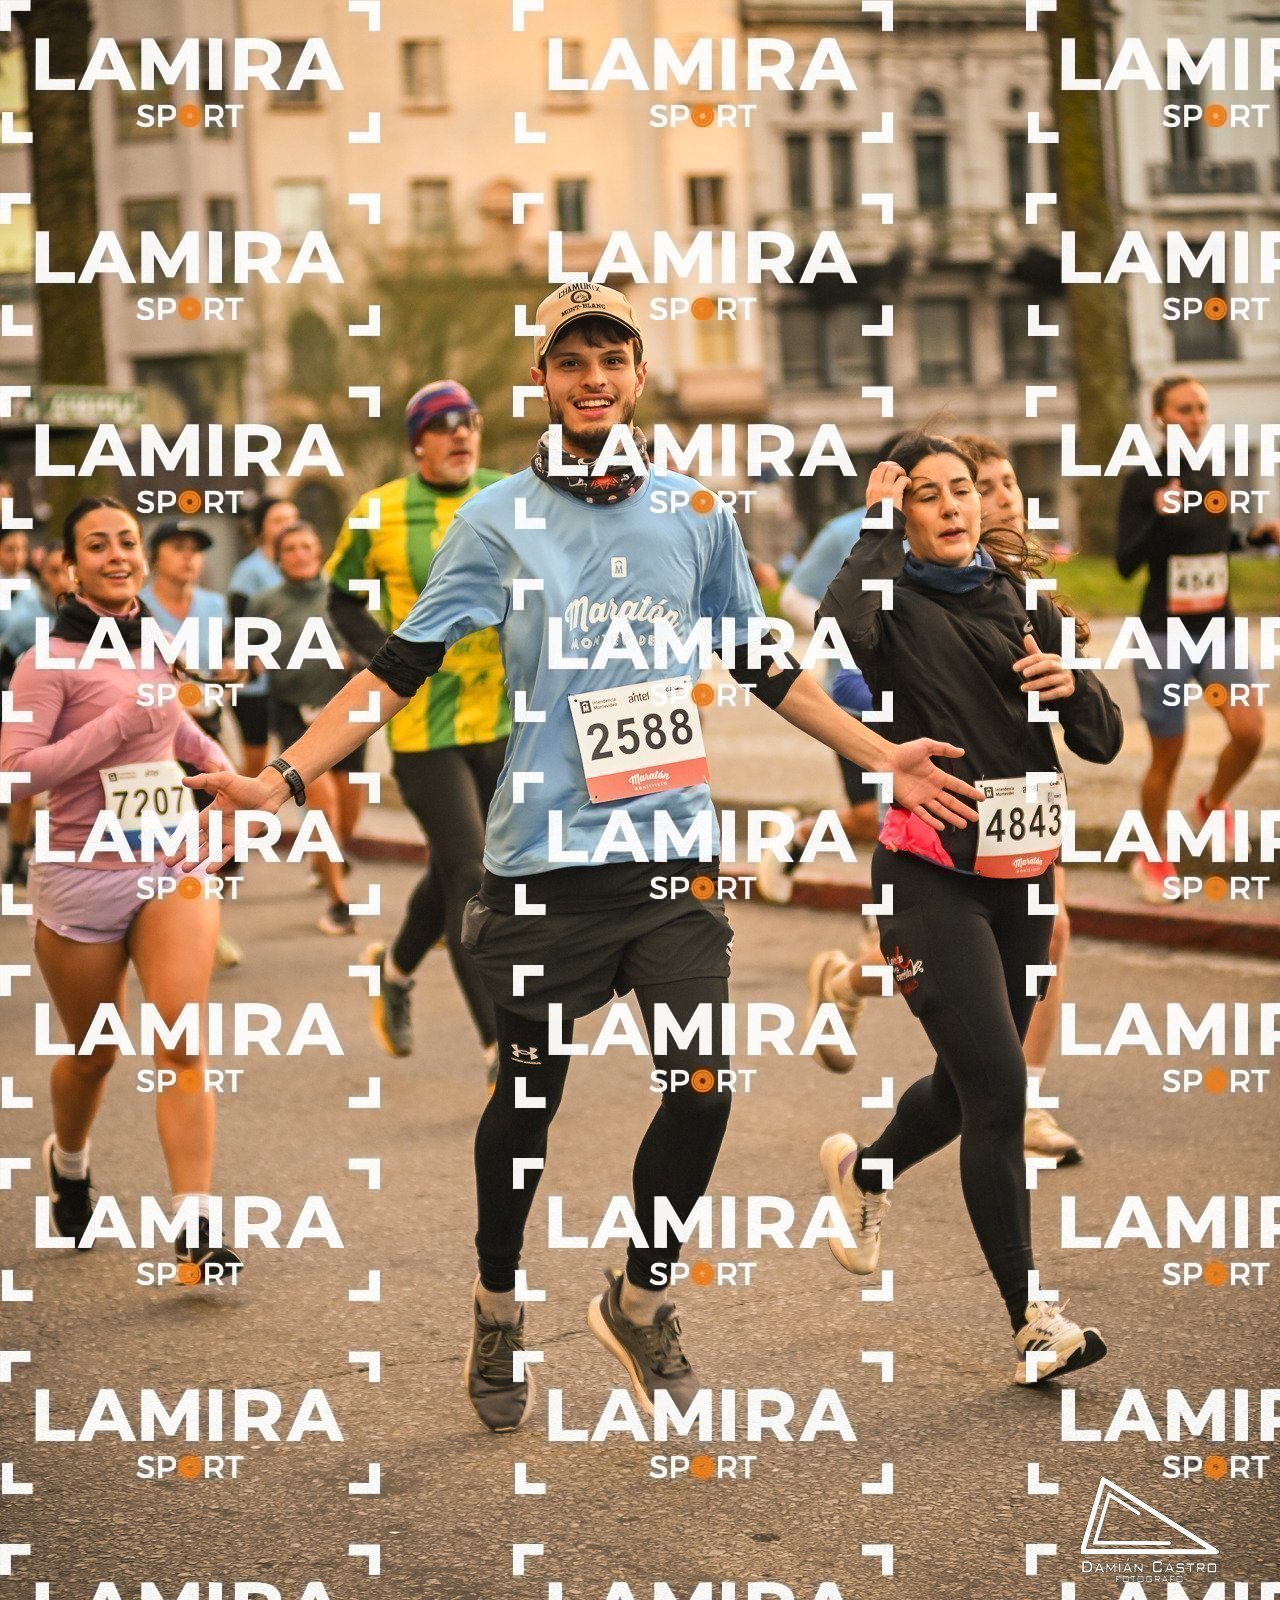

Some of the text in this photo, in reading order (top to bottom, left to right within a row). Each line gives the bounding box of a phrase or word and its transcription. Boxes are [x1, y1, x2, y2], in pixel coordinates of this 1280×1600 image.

[564, 596, 681, 633] Maratón
[587, 708, 693, 761] 2588
[112, 785, 184, 820] 7207
[986, 804, 1062, 842] 4843
